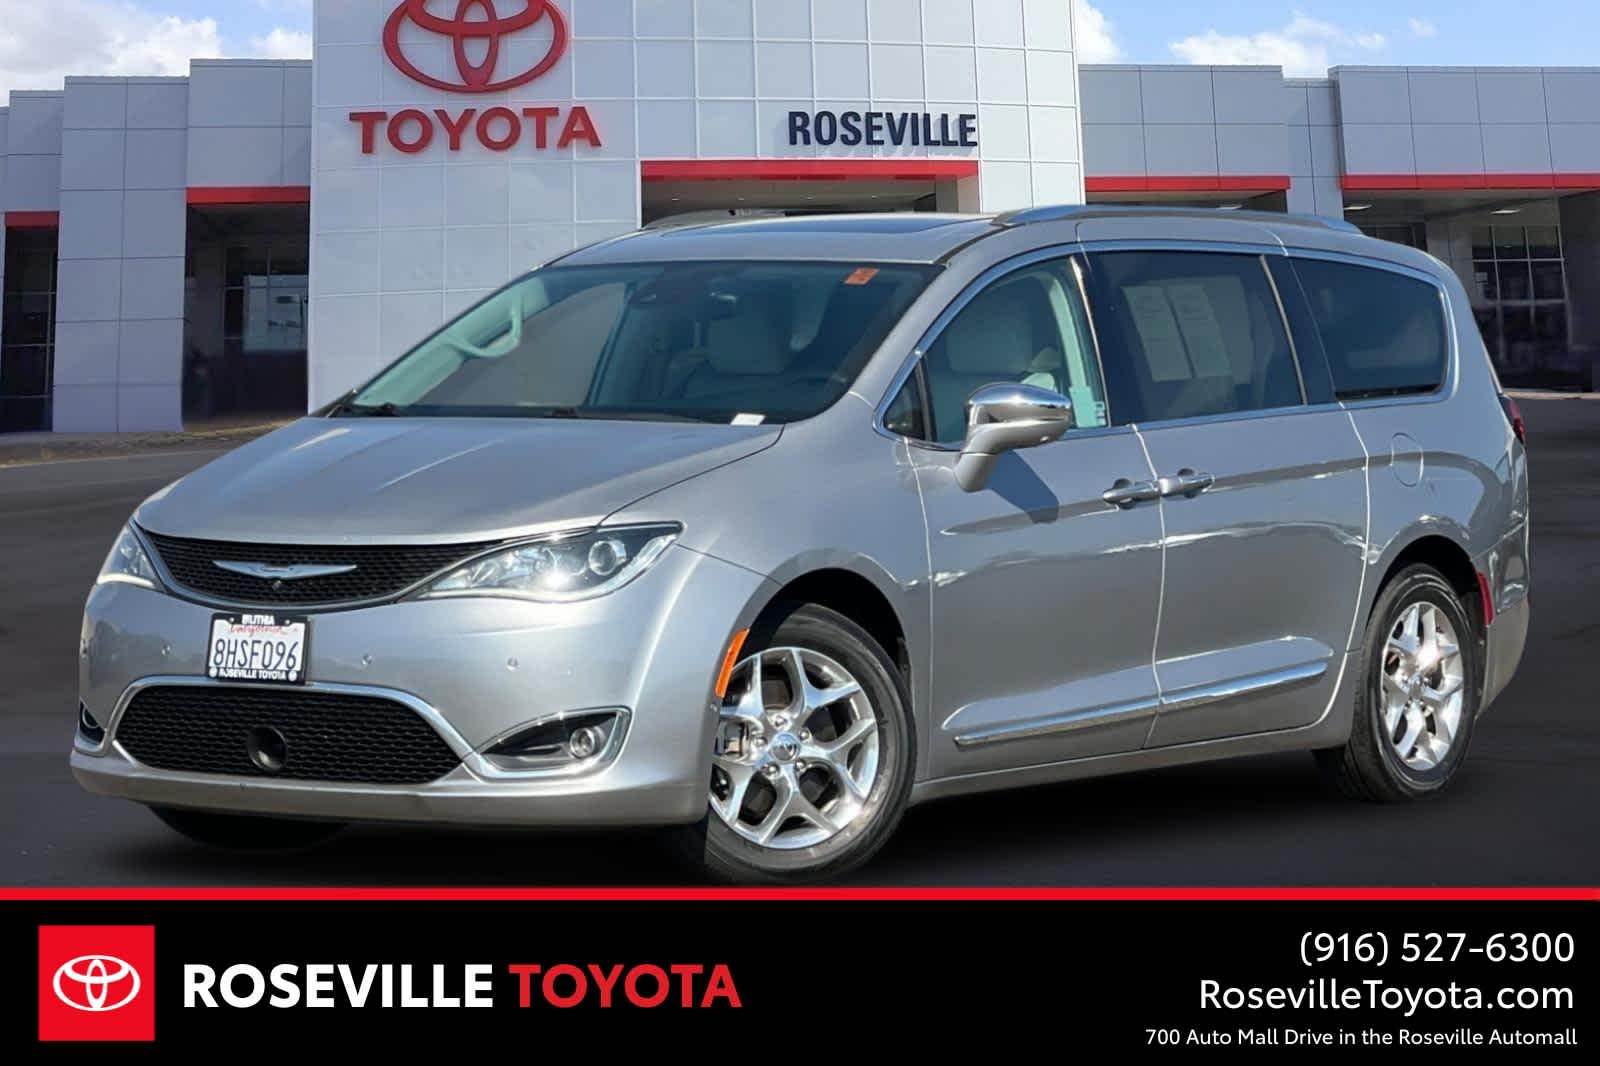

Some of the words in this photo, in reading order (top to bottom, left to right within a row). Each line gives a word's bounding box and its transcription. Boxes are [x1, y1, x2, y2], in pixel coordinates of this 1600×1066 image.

[349, 105, 602, 154] TOYOTA
[788, 110, 978, 149] ROSEVILLE
[213, 638, 299, 671] 8HSF096
